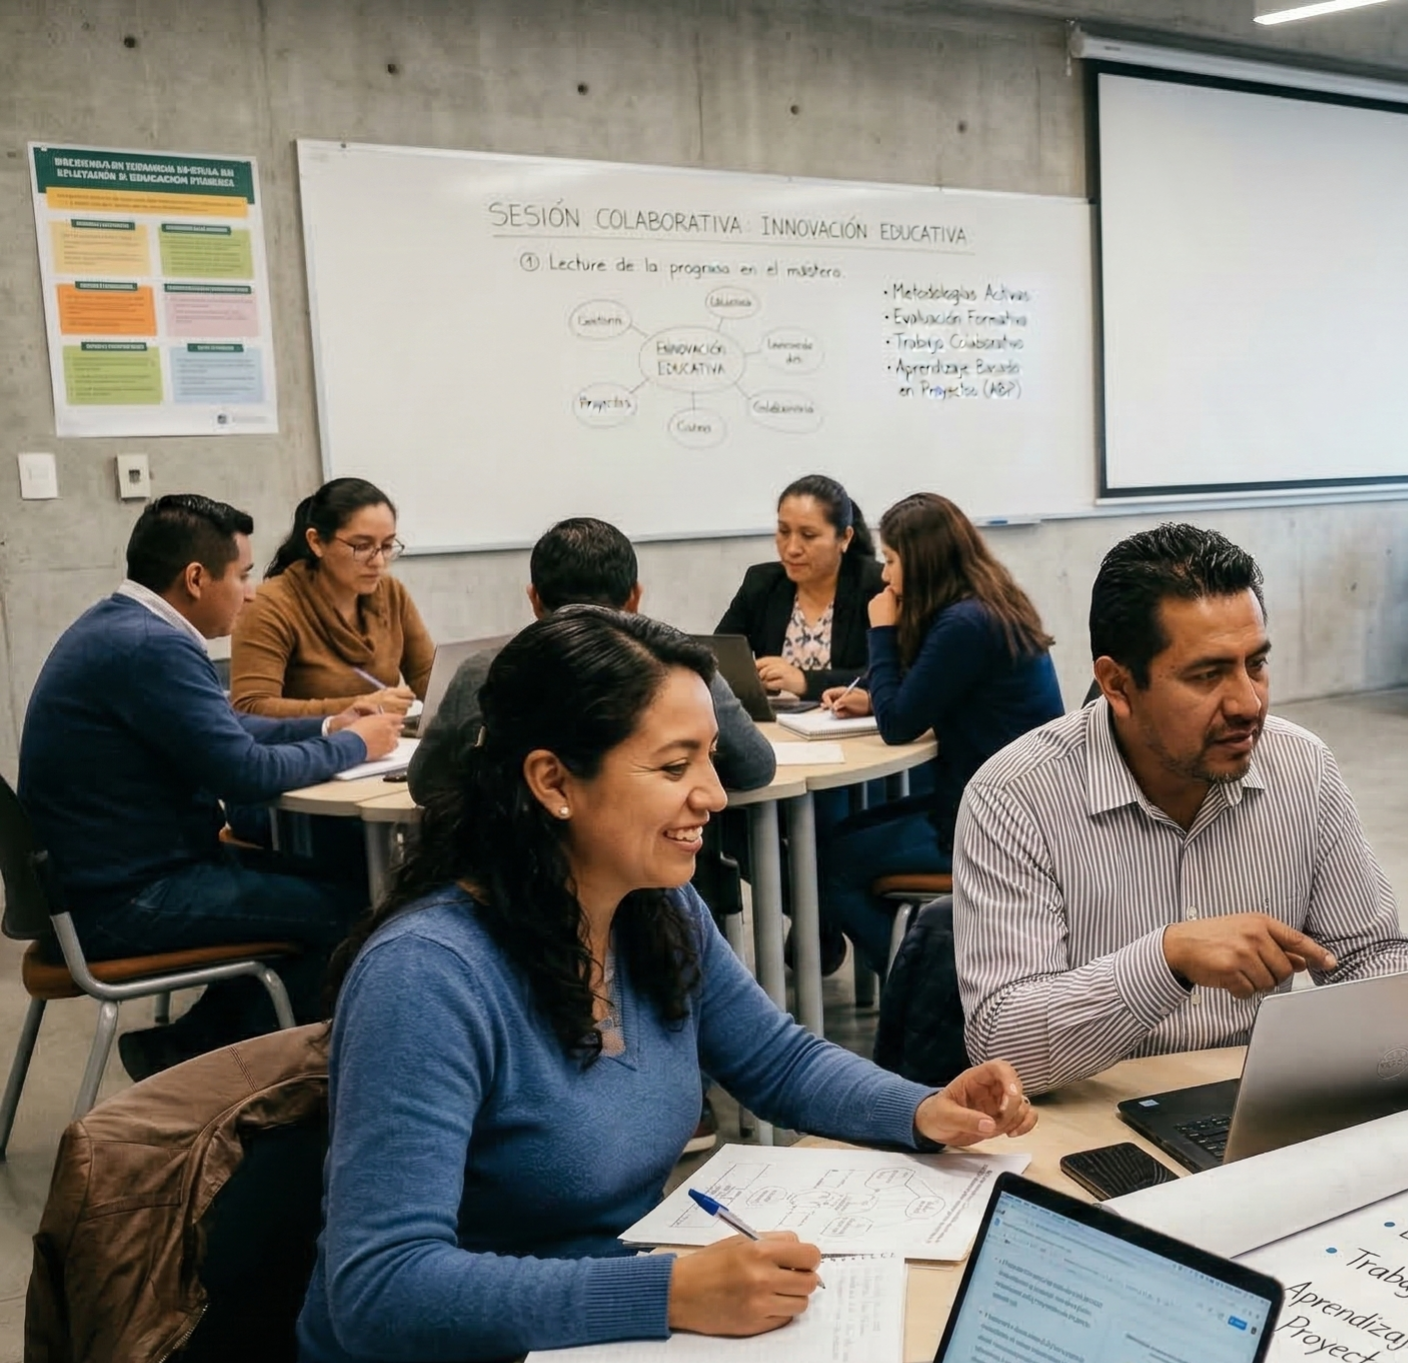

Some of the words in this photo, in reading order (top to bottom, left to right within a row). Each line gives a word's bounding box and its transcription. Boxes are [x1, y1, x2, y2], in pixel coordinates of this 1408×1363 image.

[488, 198, 580, 228] SESIÓN
[761, 215, 867, 239] INNOVACIÓN
[880, 223, 967, 243] EDUCATIVA
[549, 253, 607, 272] Lecture
[616, 253, 634, 272] de
[645, 257, 658, 273] la
[740, 267, 757, 276] en
[767, 259, 778, 276] el
